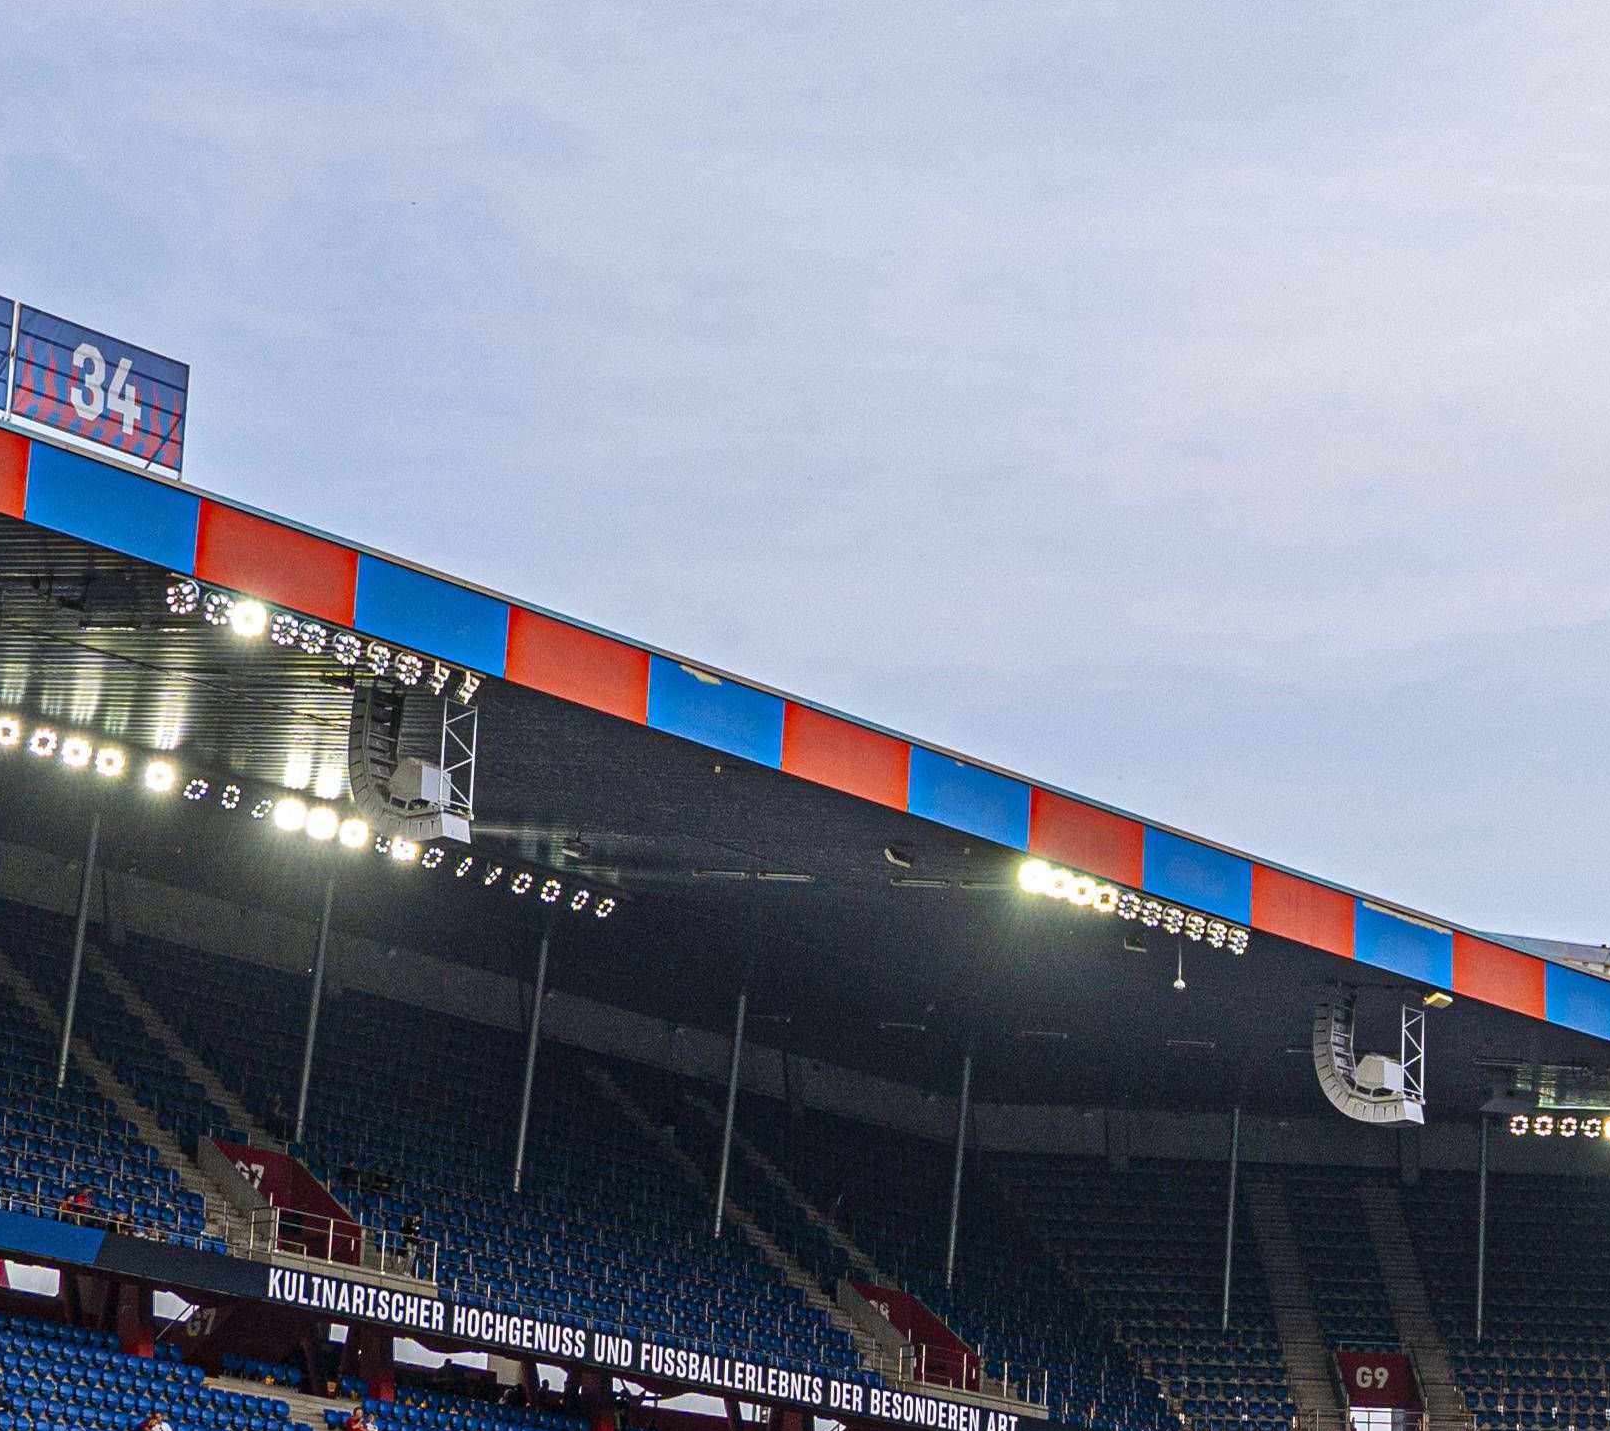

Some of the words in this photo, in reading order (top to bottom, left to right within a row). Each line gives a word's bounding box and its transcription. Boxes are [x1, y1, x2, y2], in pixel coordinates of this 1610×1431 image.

[70, 343, 142, 436] 34
[267, 1268, 445, 1332] KULINARISCHER
[452, 1304, 587, 1359] HOCHGENUSS
[593, 1333, 634, 1368] UND
[640, 1341, 824, 1406] FUSSBALLERLEBNIS
[829, 1380, 864, 1413] DER
[1356, 1366, 1389, 1389] G9
